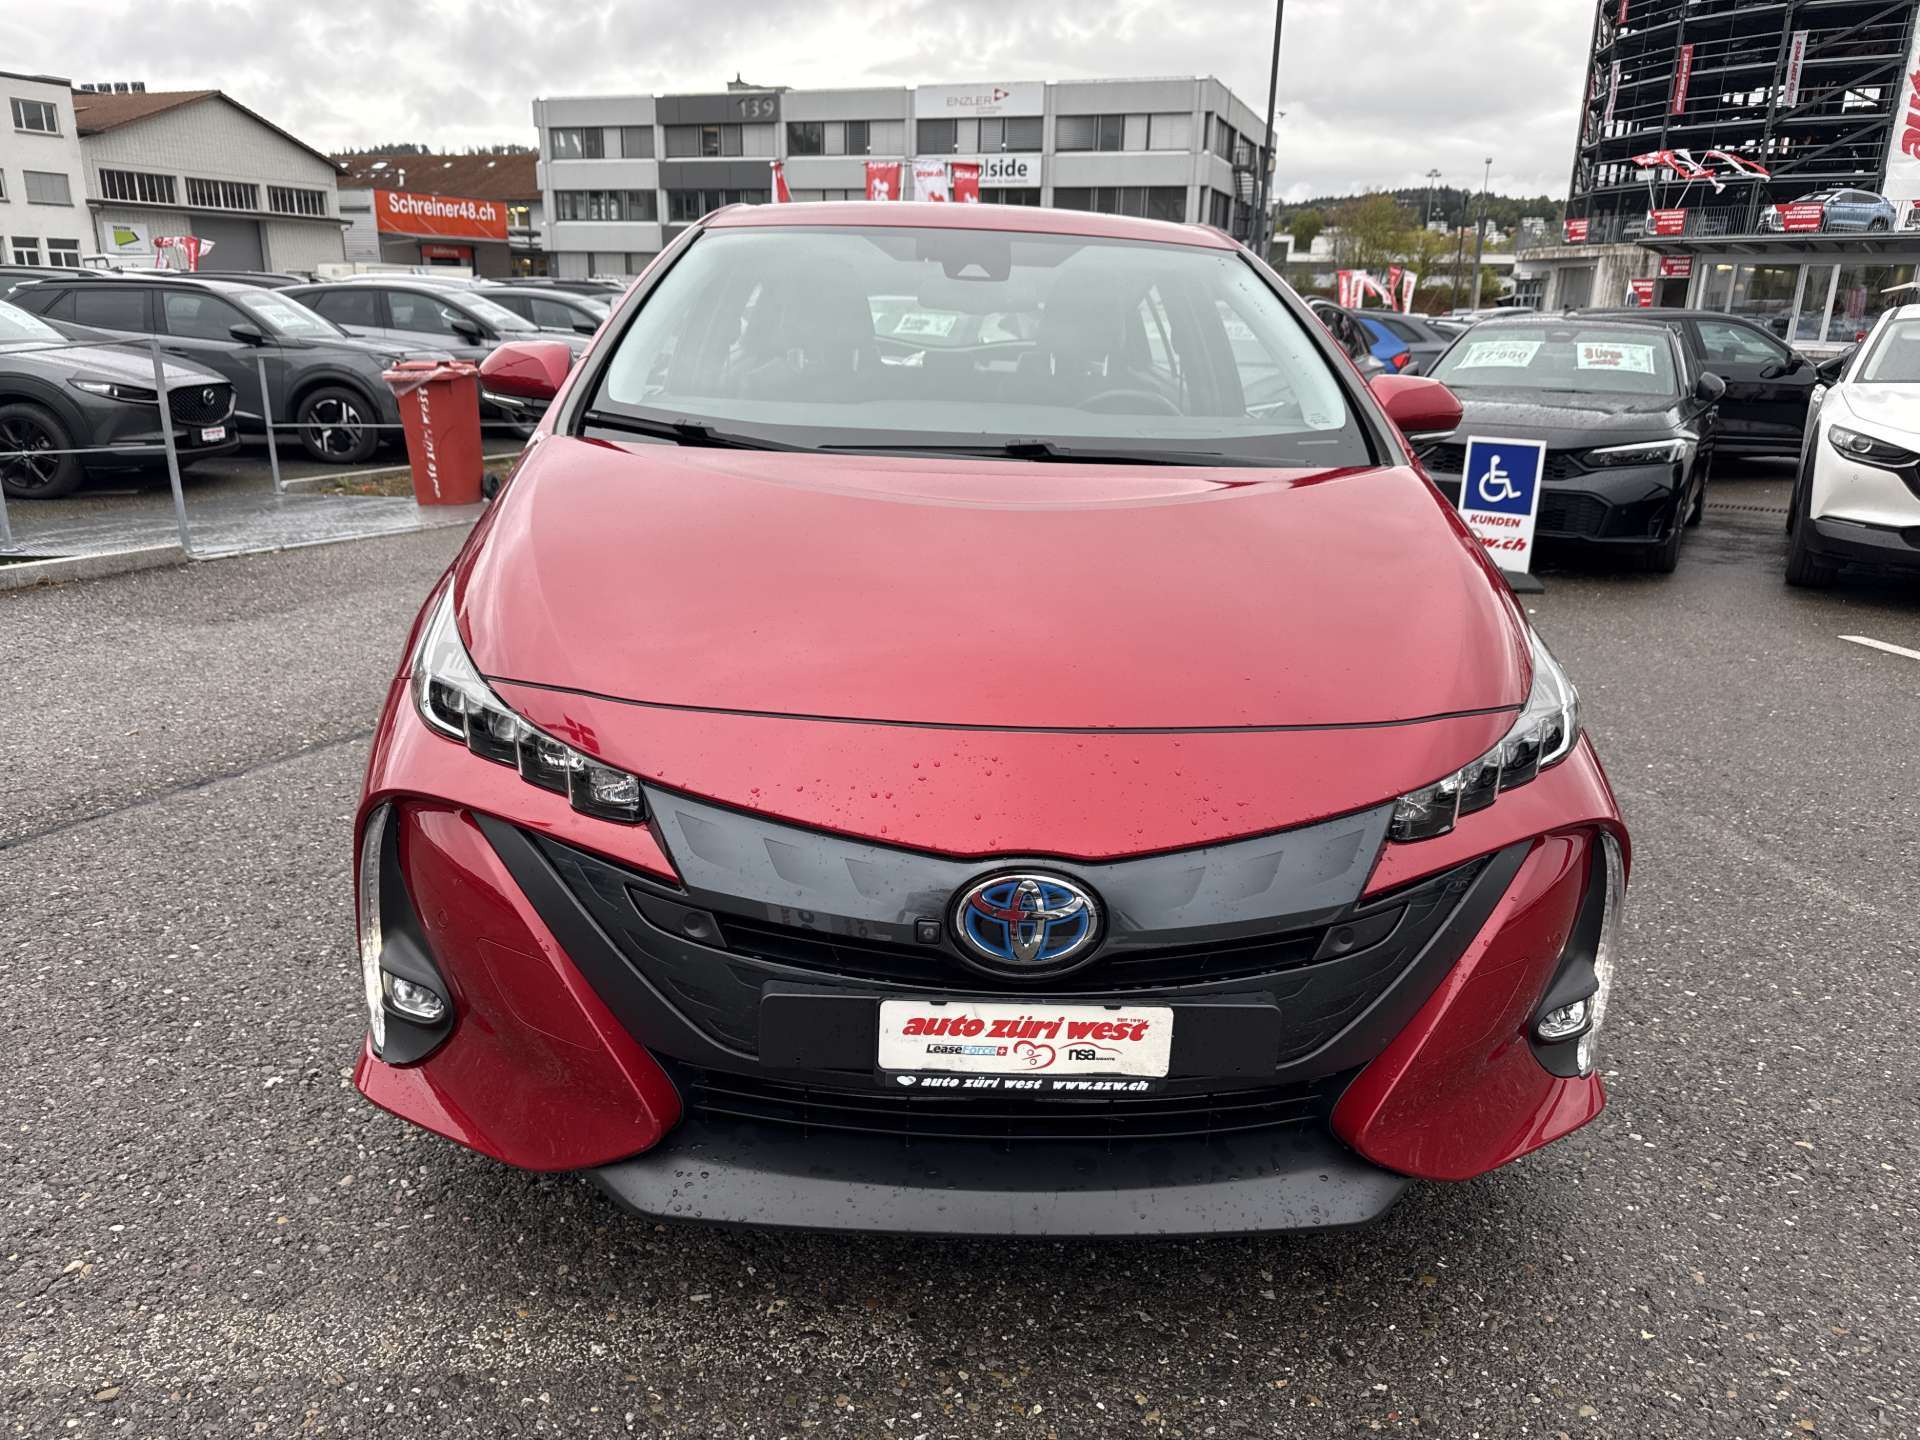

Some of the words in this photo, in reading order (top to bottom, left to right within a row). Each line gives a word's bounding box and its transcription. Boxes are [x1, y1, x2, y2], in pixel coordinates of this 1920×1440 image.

[945, 95, 992, 106] ENZLER
[738, 98, 775, 118] 139
[389, 193, 496, 221] Schreiner48.ch
[1470, 514, 1521, 528] KUNDEN
[1480, 537, 1527, 551] w.ch
[902, 1013, 986, 1039] auto
[985, 1015, 1066, 1039] züri
[1067, 1018, 1150, 1042] west
[926, 1043, 996, 1057] LeaseForce
[1068, 1048, 1095, 1061] nsa
[921, 1077, 960, 1088] auto
[963, 1076, 1000, 1089] züri
[1004, 1078, 1043, 1090] west
[1053, 1079, 1149, 1091] www.azw.ch
